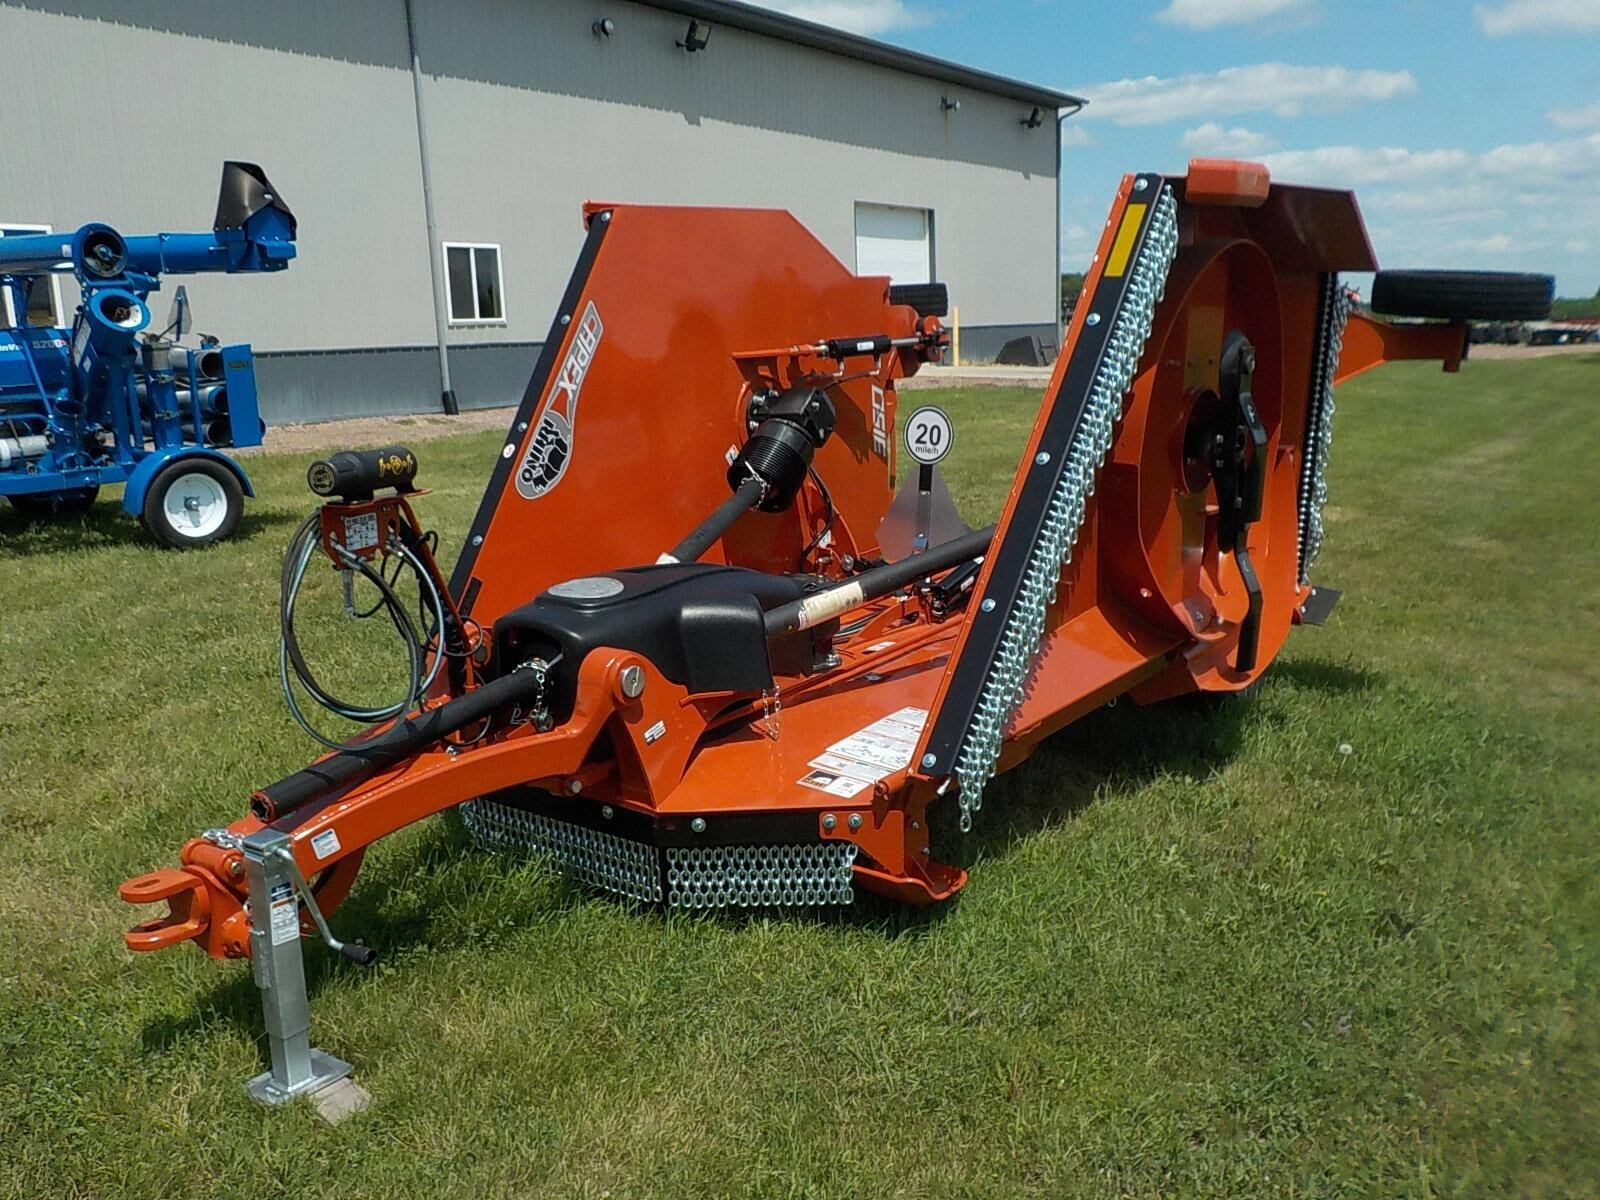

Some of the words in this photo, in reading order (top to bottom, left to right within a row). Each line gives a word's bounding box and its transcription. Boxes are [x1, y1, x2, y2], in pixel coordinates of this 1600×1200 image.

[558, 317, 597, 401] APEX
[520, 416, 561, 484] RHINO
[915, 423, 941, 446] 20
[915, 446, 939, 455] mile/h
